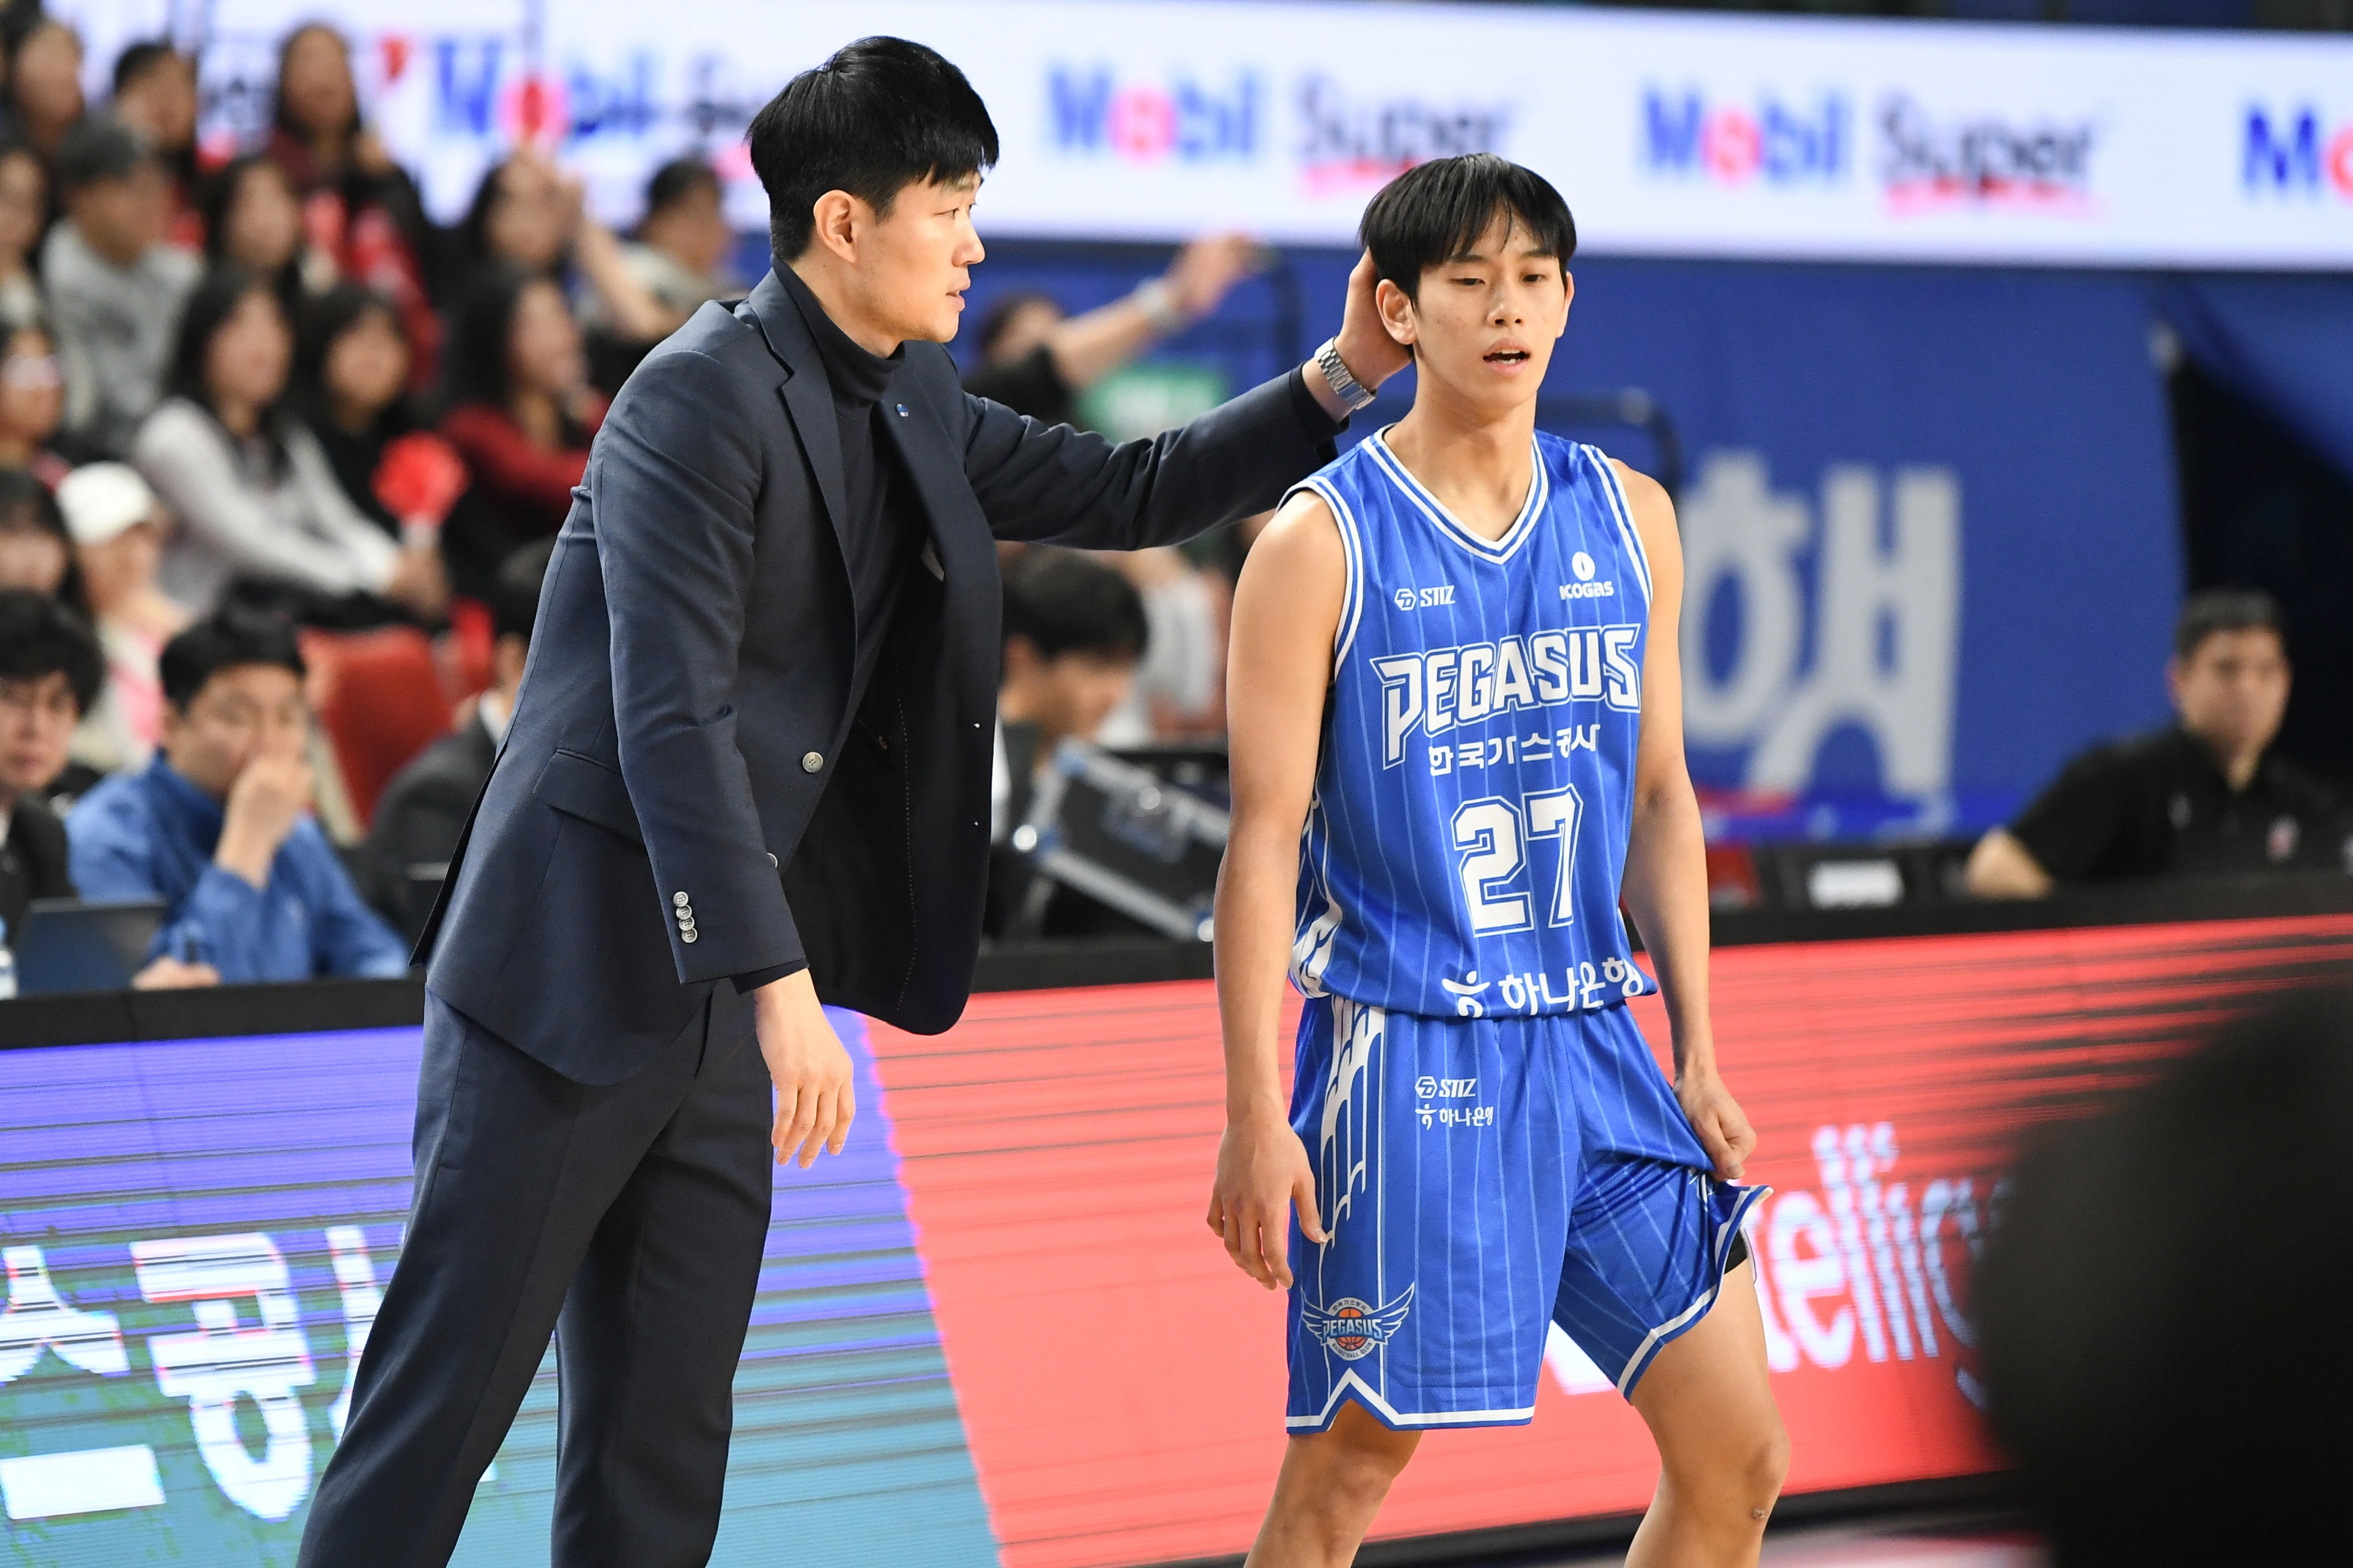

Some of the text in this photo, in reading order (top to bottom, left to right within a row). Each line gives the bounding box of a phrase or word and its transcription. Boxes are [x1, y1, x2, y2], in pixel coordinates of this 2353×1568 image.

[1049, 64, 1257, 162] Mobil
[1641, 84, 2095, 197] Mobil Super
[1419, 585, 1456, 607] STIZ
[1369, 623, 1641, 769] PEGASUS
[1451, 783, 1583, 938] 27
[1439, 1078, 1477, 1098] STIZ
[1322, 1319, 1382, 1342] PEGASUS
[1332, 1342, 1372, 1358] BASKETBALL CLUB
